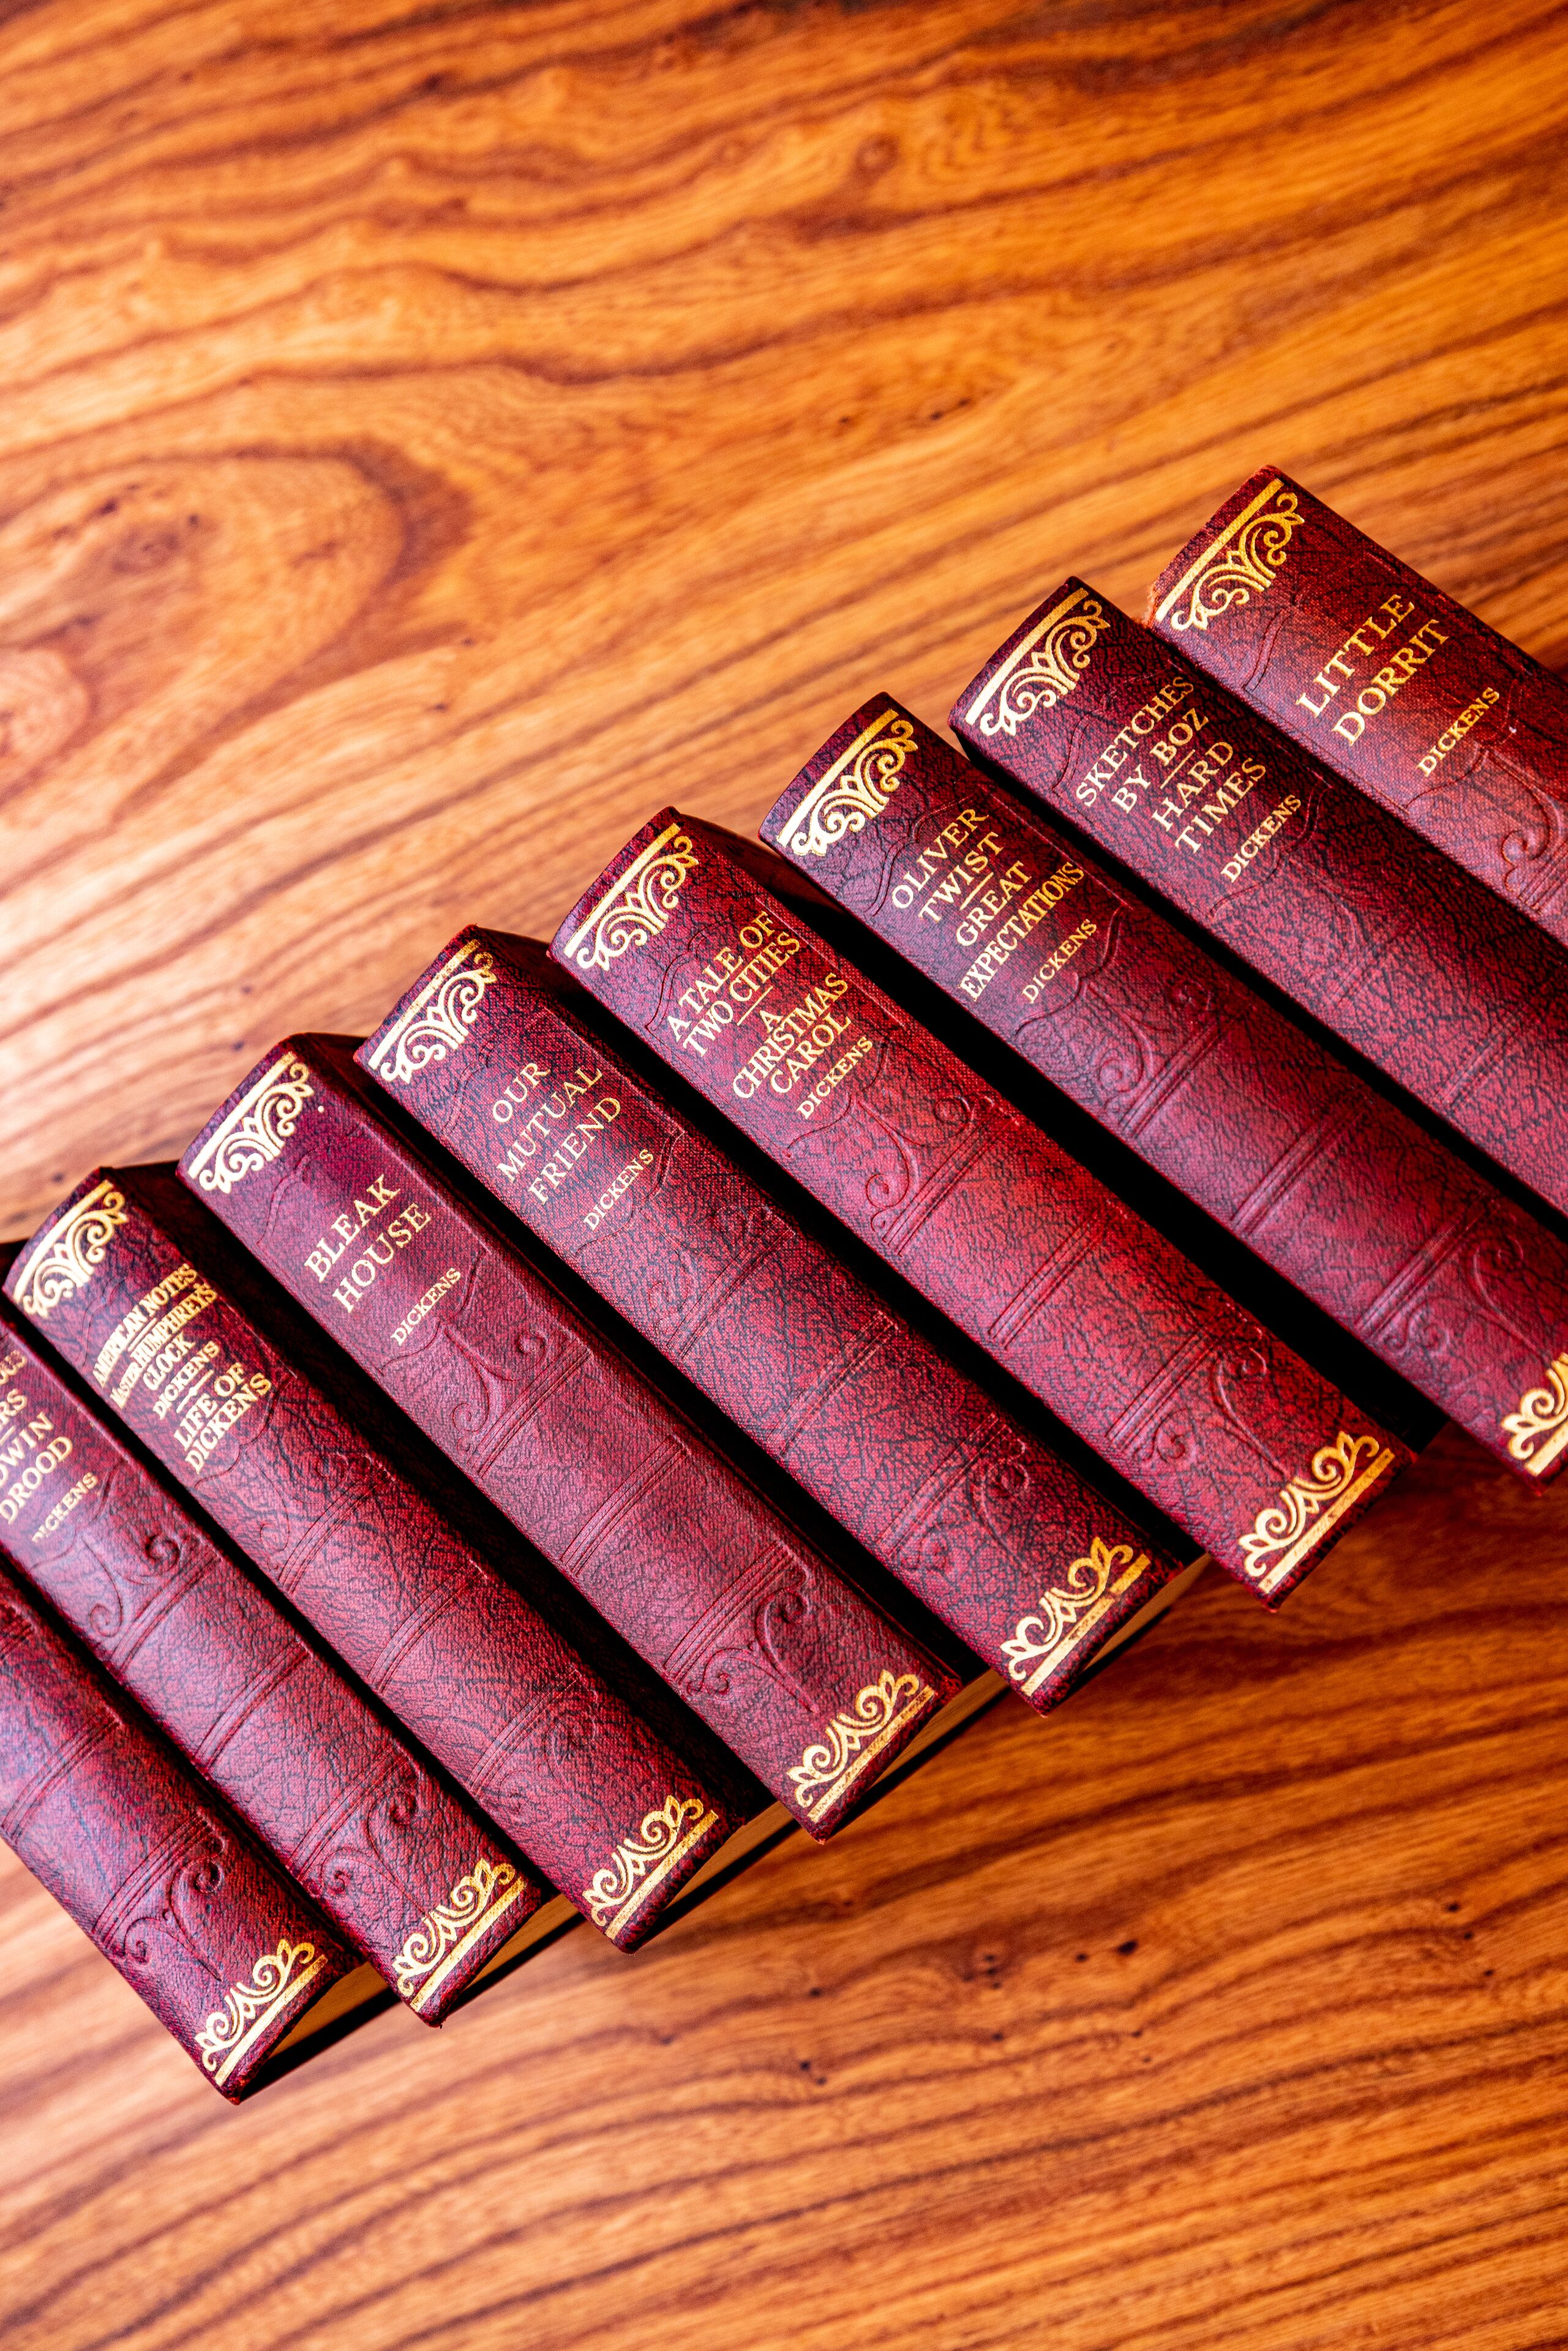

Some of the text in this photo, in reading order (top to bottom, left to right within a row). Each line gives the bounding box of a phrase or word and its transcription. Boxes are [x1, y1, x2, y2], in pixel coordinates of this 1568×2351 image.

[1294, 594, 1415, 719] LITTLE
[1331, 619, 1449, 747] DORRIT
[1075, 675, 1195, 808] SKETCHES
[1111, 708, 1209, 814] BY BOZ
[1416, 687, 1499, 778] DICKENS
[1151, 741, 1233, 833] HARD
[1174, 761, 1266, 854] TIMES
[891, 808, 990, 909] OLIVER
[918, 831, 1003, 924] TWIST
[1220, 798, 1301, 883] DICKENS
[956, 860, 1030, 947] GREAT
[957, 861, 1084, 1002] EXPECTATIONS
[667, 910, 775, 1043] A TALE OF
[682, 931, 800, 1057] TWO CITIES
[1021, 923, 1097, 1004] DICKENS
[732, 972, 848, 1099] CHRISTMAS
[759, 1010, 784, 1034] A
[770, 1012, 852, 1095] CAROL
[492, 1062, 551, 1123] OUR
[796, 1036, 873, 1120] DICKENS
[497, 1067, 603, 1184] MUTUAL
[527, 1097, 621, 1205] FRIEND
[303, 1174, 401, 1284] BLEAK
[583, 1149, 654, 1231] DICKENS
[332, 1202, 432, 1313] HOUSE
[92, 1263, 197, 1389] AMERICAN NOTES
[130, 1283, 217, 1370] HUMPHREY'S
[390, 1267, 461, 1346] DICKENS
[143, 1330, 196, 1391] CLOCK
[152, 1340, 220, 1421] DICKENS
[173, 1362, 246, 1452] LIFE OF
[185, 1372, 272, 1475] DICKENS
[0, 1436, 73, 1524] DROOD
